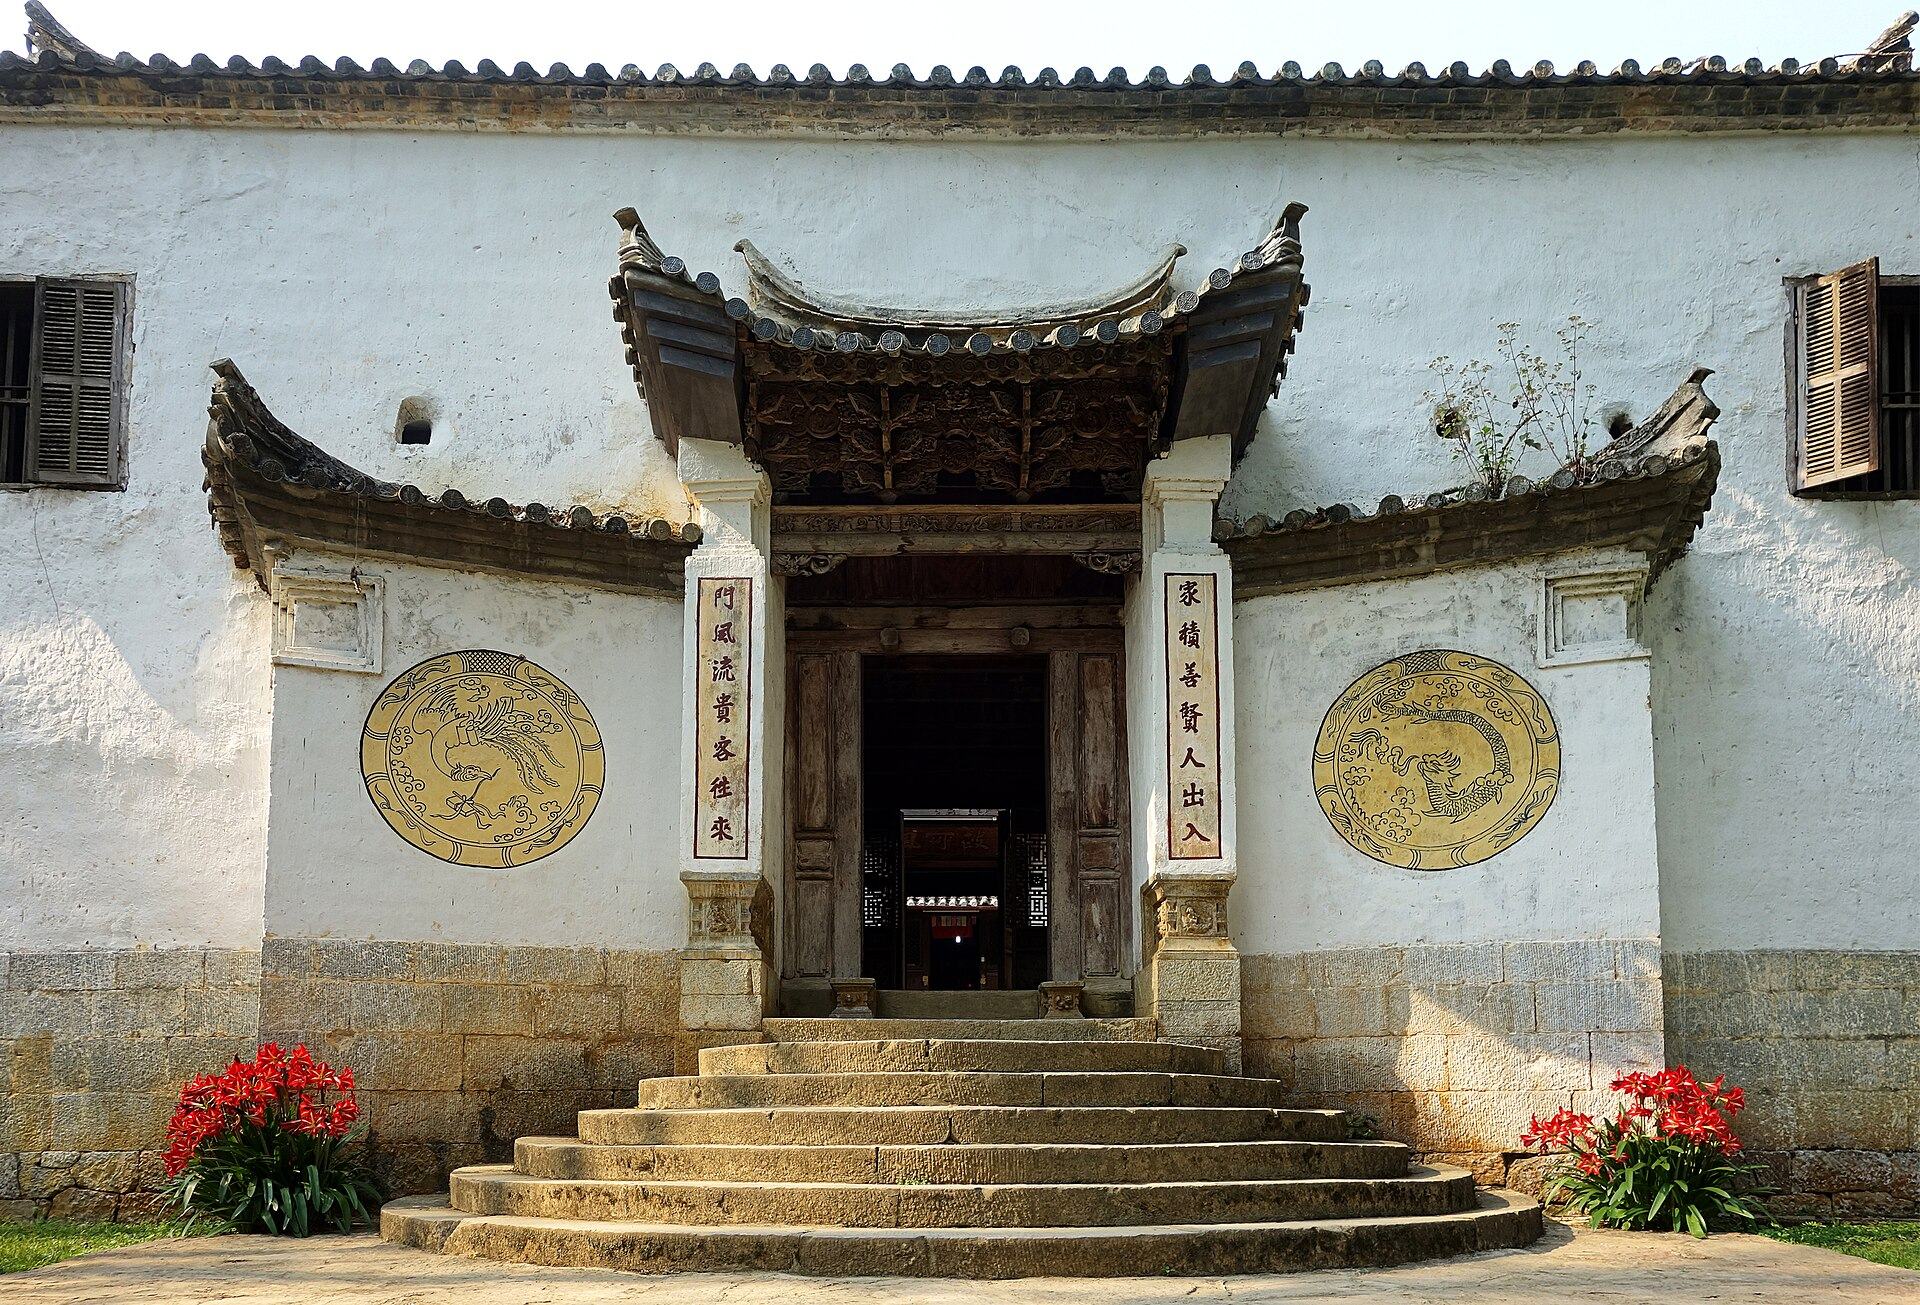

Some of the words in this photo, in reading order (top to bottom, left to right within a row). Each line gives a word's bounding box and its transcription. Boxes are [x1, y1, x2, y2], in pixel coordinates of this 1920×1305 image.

[1178, 580, 1211, 842] 家積善賢人出入
